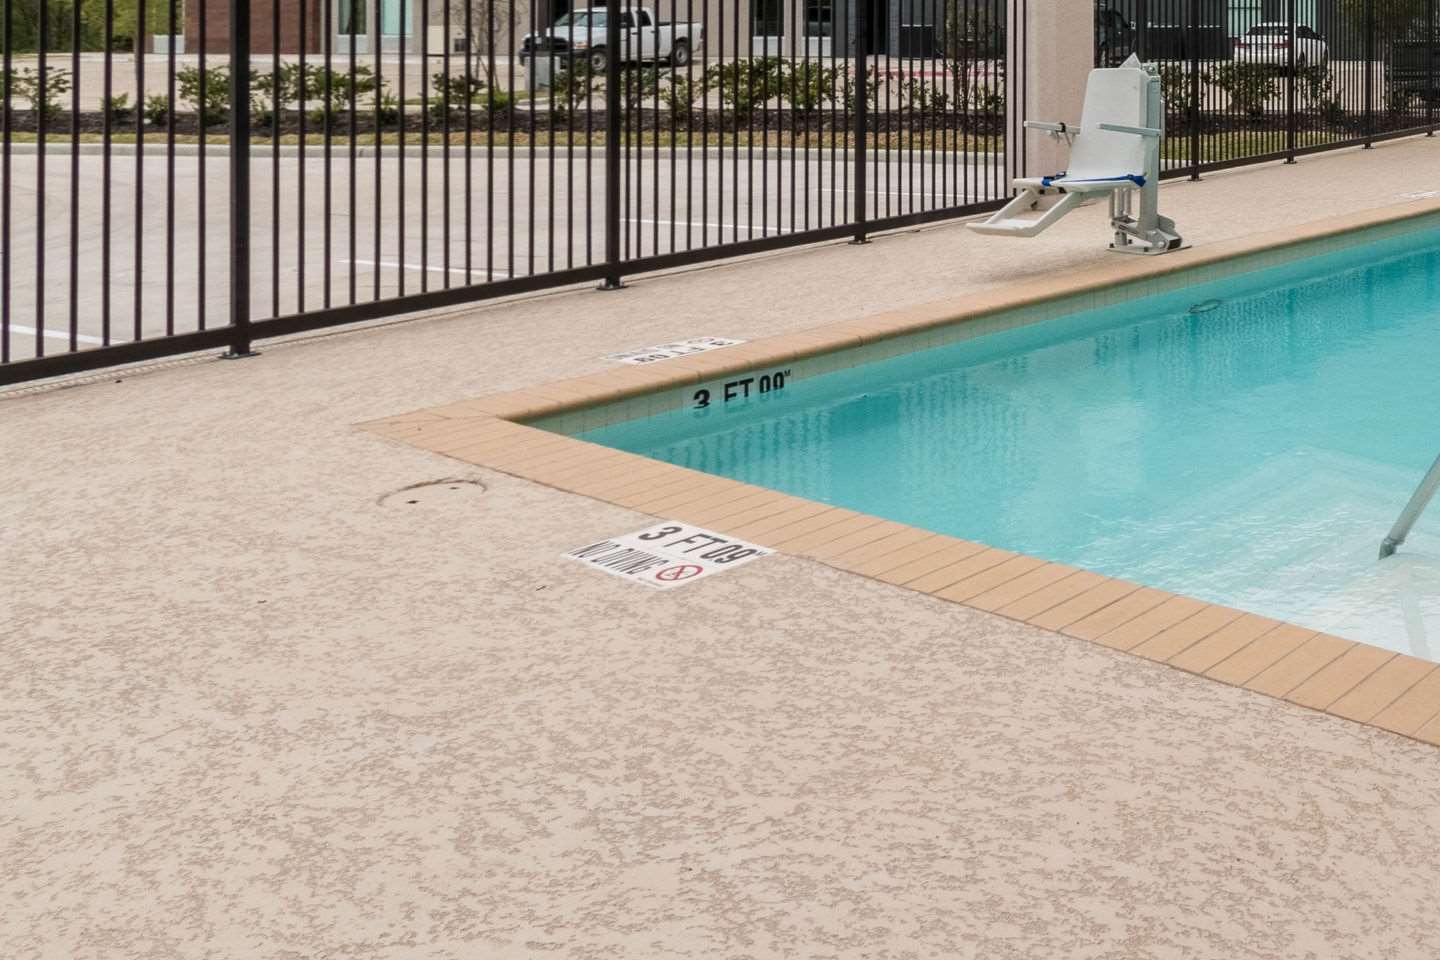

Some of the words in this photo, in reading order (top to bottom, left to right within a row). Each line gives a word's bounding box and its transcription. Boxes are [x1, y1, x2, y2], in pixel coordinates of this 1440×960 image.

[693, 389, 710, 410] 3
[724, 377, 754, 402] FT
[567, 540, 621, 558] NO
[638, 526, 682, 540] 3
[664, 533, 729, 553] FT
[590, 548, 669, 575] DIVING
